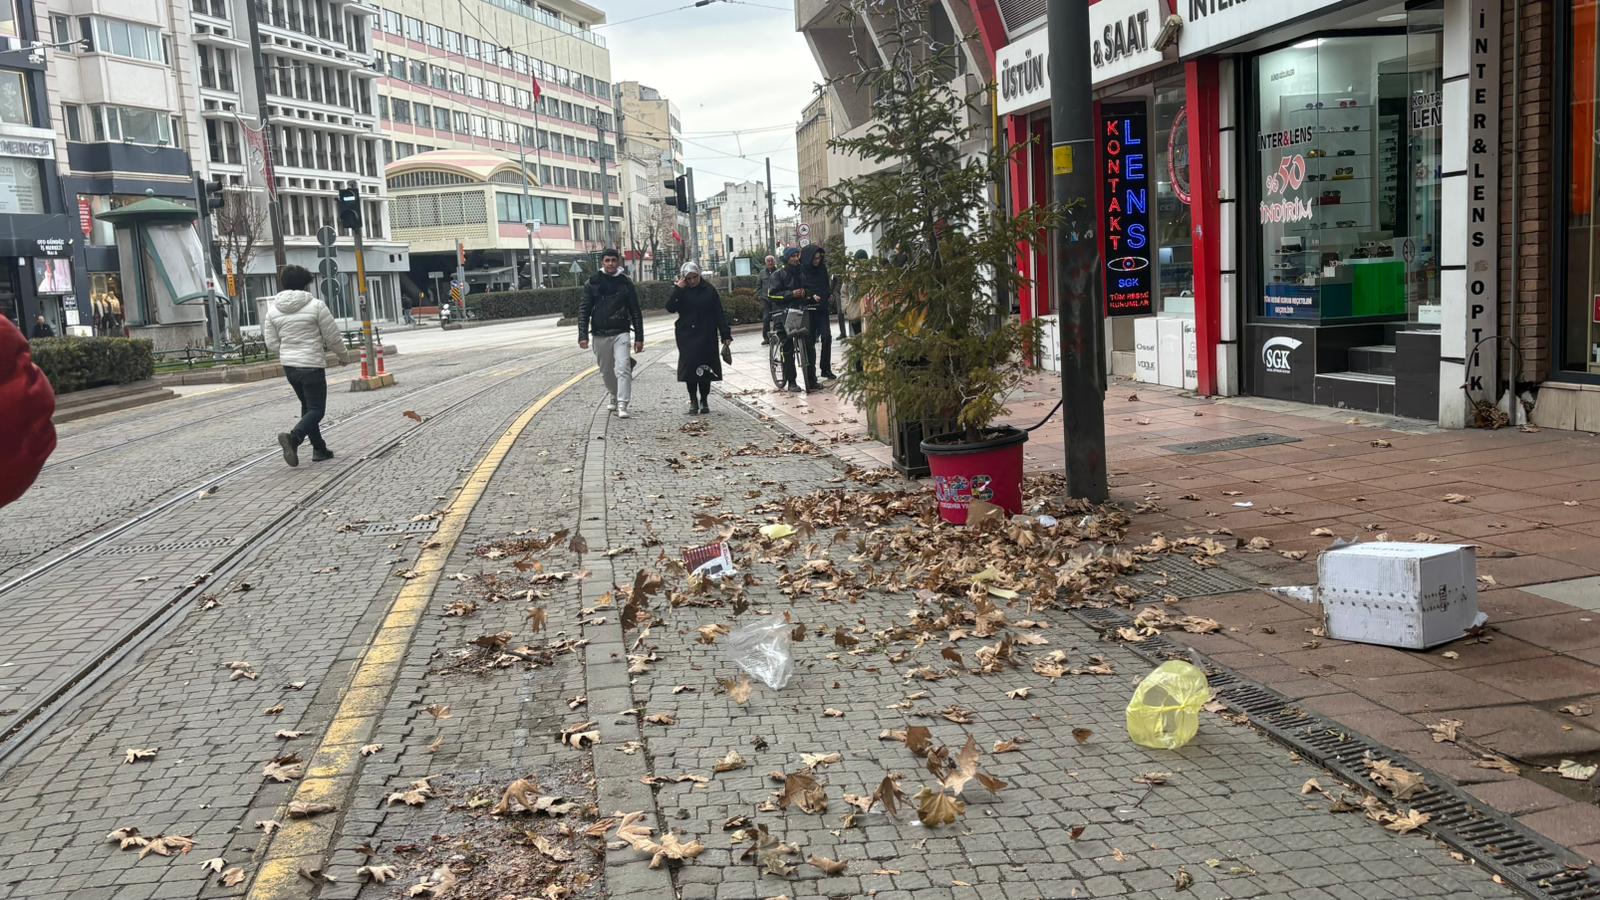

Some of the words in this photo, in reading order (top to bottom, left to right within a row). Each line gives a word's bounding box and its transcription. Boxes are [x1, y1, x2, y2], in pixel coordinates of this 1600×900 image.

[1092, 39, 1104, 69] &
[1104, 9, 1149, 64] SAAT
[1002, 48, 1044, 100] ÜSTÜN
[1107, 120, 1121, 250] KONTAKT
[1124, 119, 1146, 248] LENS
[1260, 196, 1312, 224] İNDİRİM
[1118, 278, 1139, 288] SGK
[1266, 349, 1291, 369] SGK
